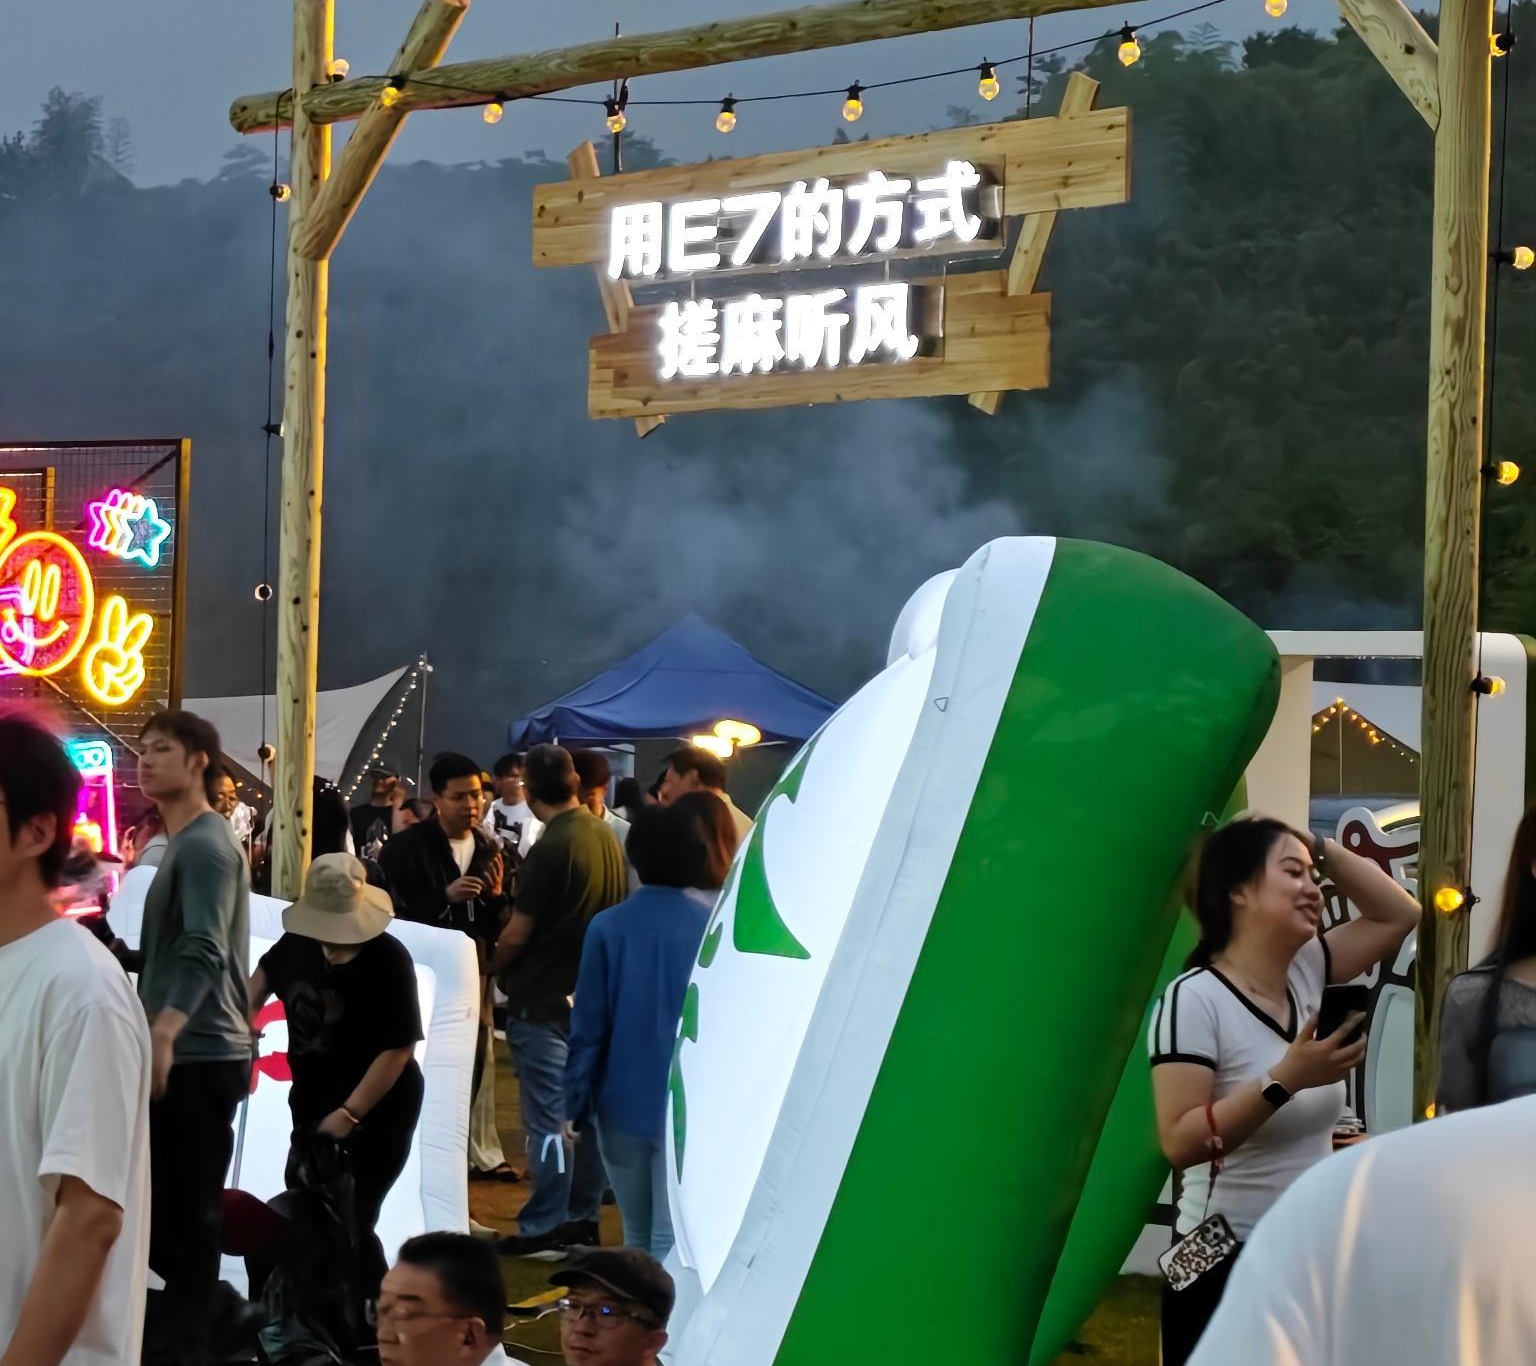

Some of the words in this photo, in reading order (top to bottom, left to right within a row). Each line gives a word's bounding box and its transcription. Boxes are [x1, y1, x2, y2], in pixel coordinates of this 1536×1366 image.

[607, 158, 982, 281] 用E7的方式
[657, 281, 919, 380] 搓麻听风
